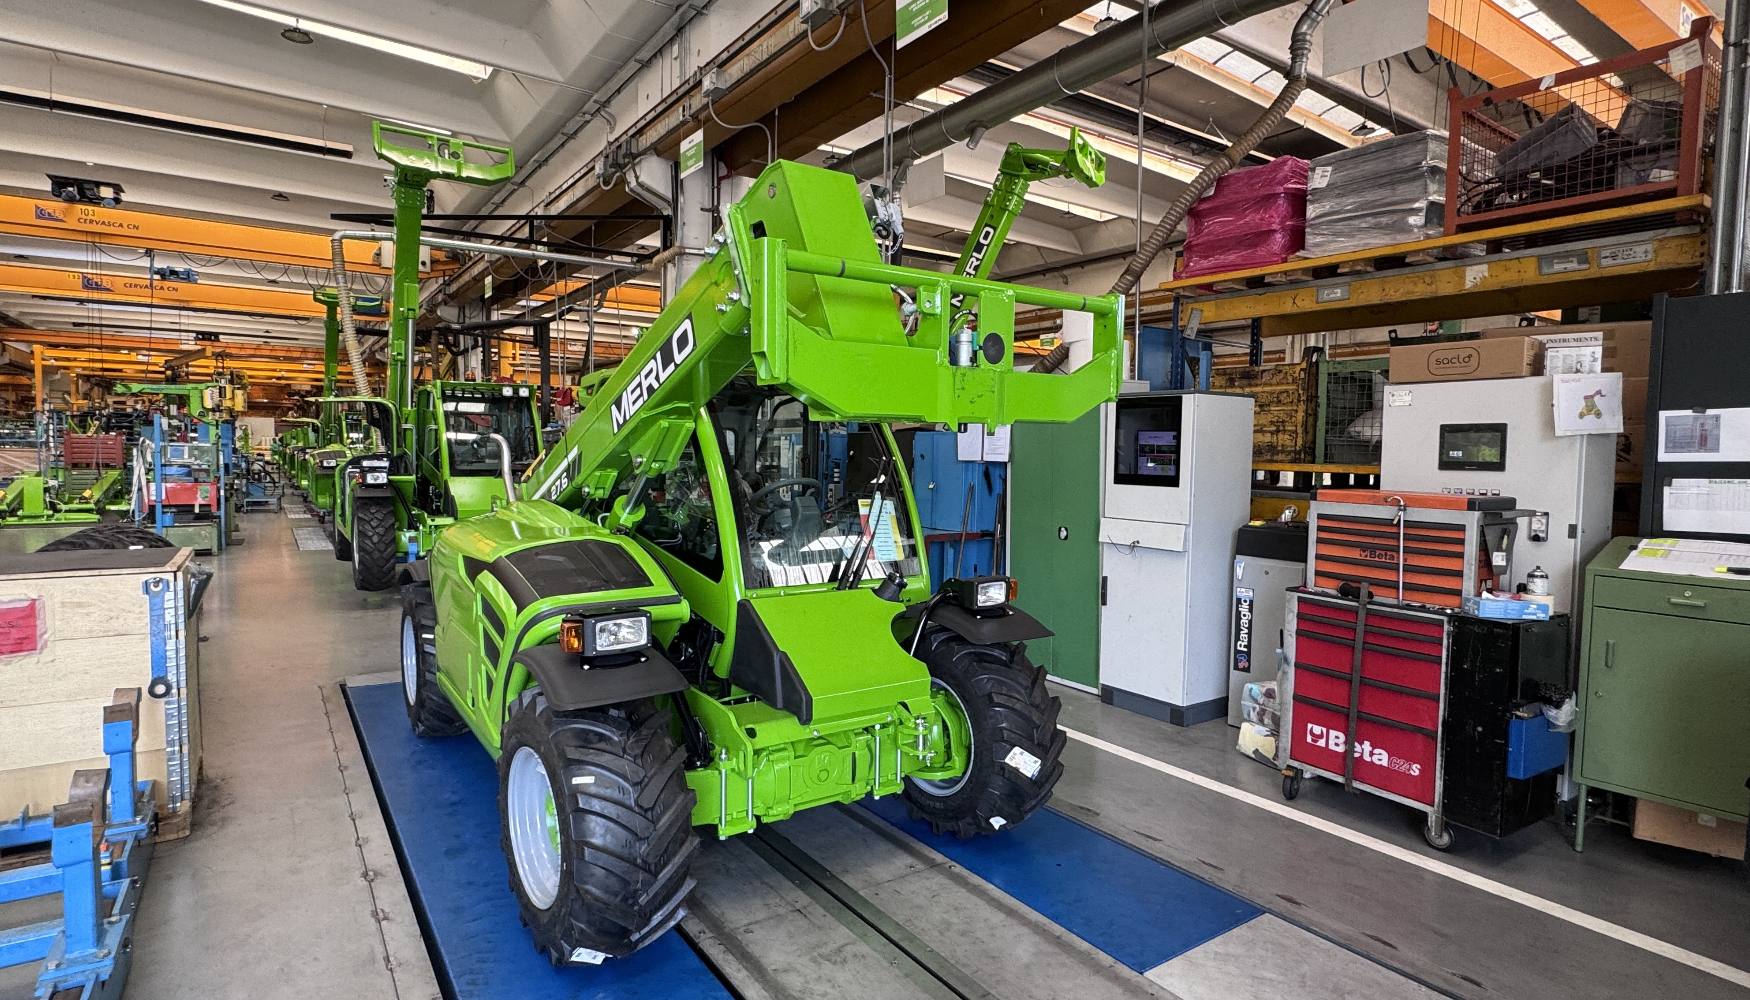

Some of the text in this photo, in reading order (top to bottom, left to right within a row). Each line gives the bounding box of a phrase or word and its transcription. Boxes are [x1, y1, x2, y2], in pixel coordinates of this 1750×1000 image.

[80, 207, 96, 217] 103
[77, 217, 140, 231] CERVASCA CN
[123, 282, 165, 292] CERVACA
[1435, 353, 1473, 366] saclo
[610, 317, 695, 435] MERLO
[550, 472, 568, 500] 27.6
[1369, 550, 1395, 561] Beta
[1328, 728, 1389, 768] Beta
